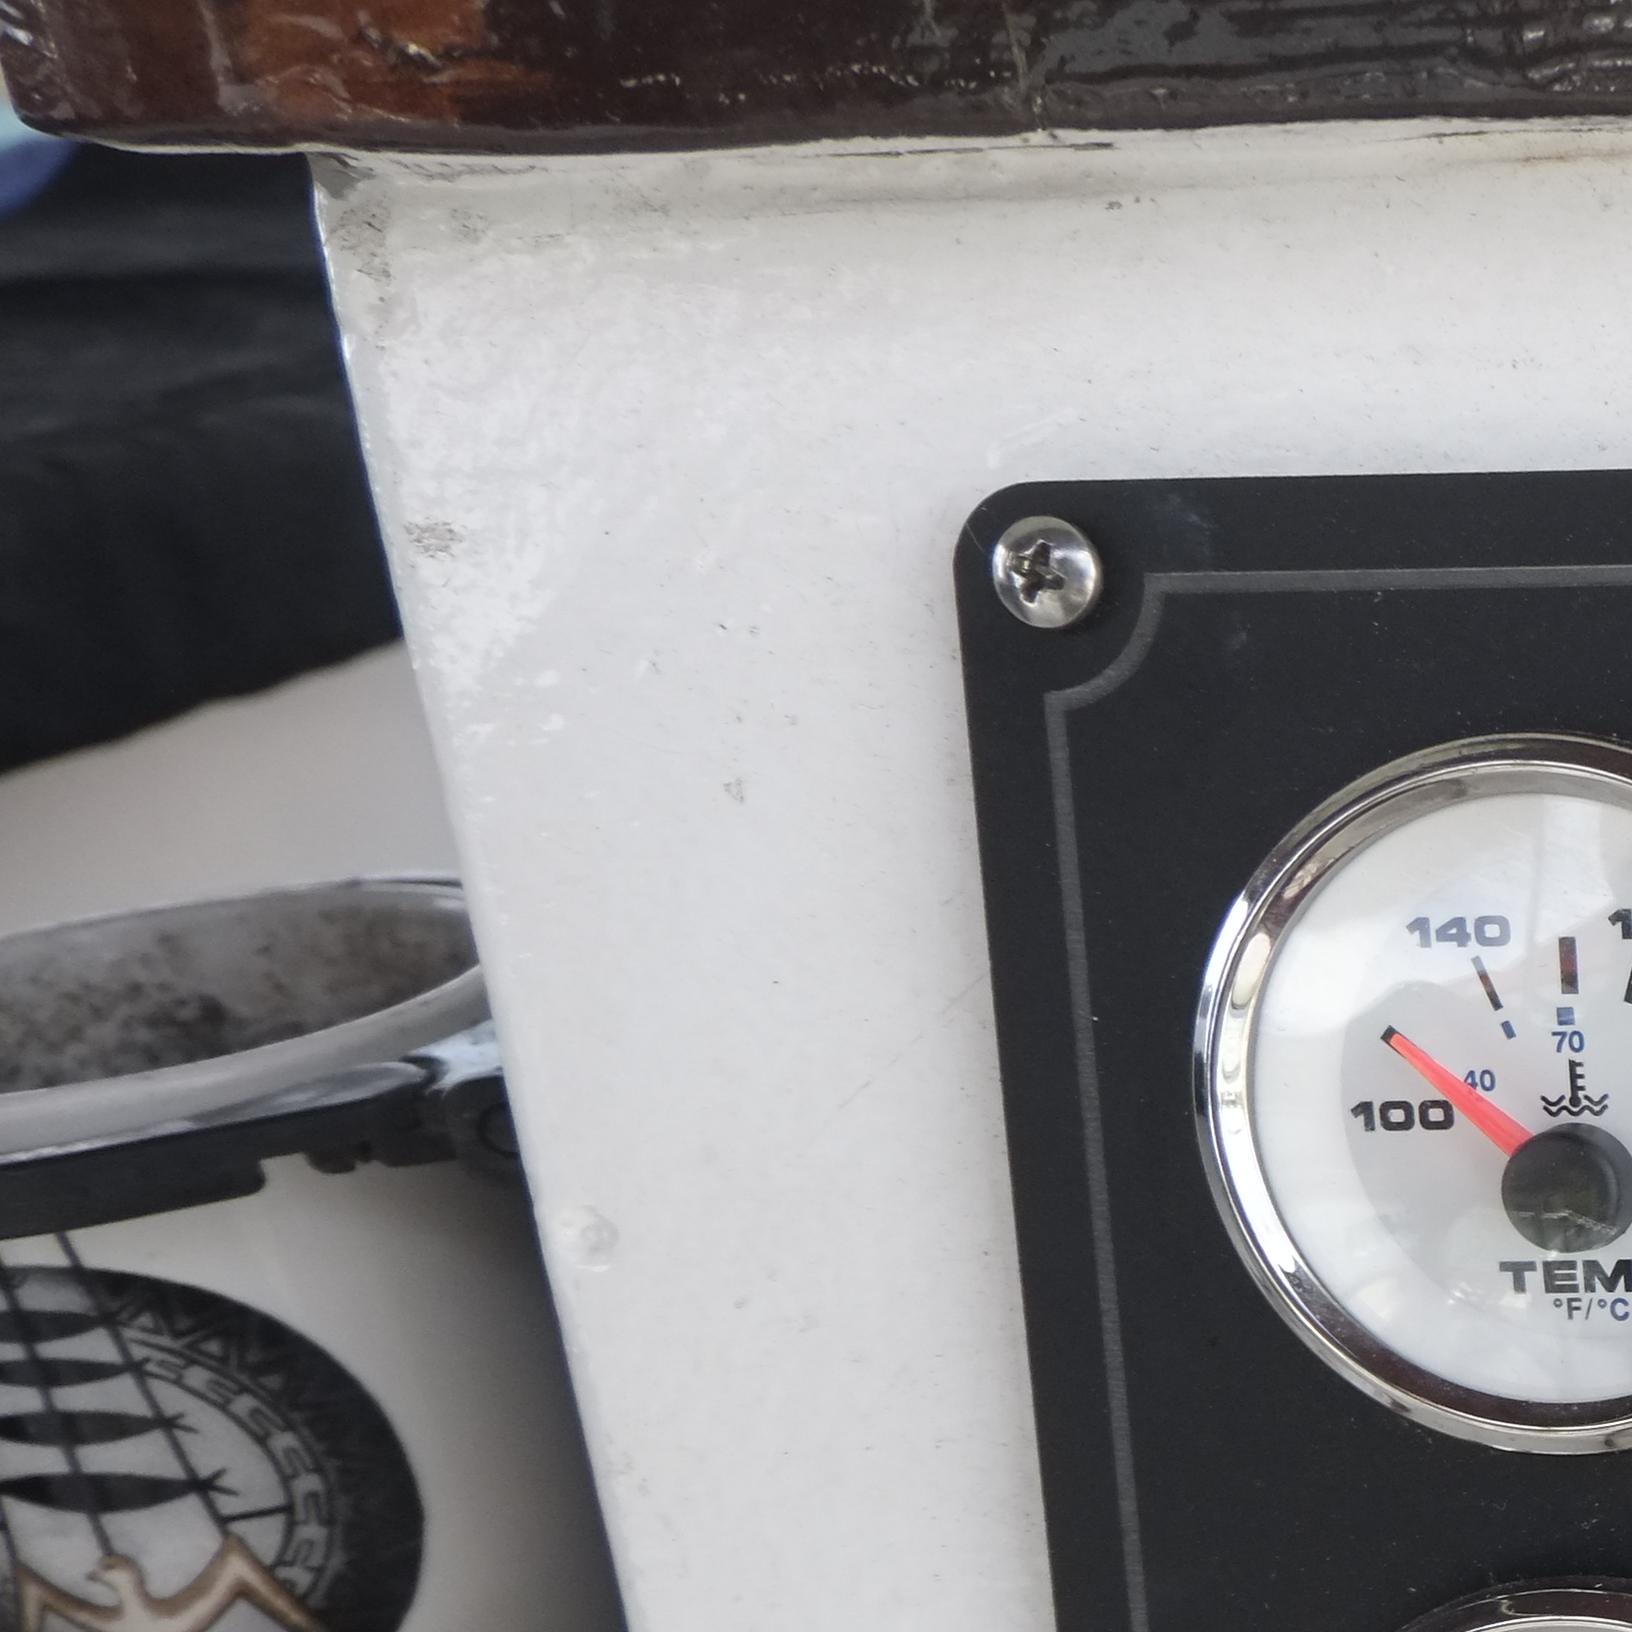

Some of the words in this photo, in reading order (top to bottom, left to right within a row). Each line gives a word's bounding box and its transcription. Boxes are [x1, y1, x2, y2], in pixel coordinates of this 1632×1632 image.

[1406, 916, 1510, 947] 140
[1551, 1031, 1584, 1052] 70
[1464, 1069, 1495, 1090] 40
[1351, 1100, 1453, 1131] 100
